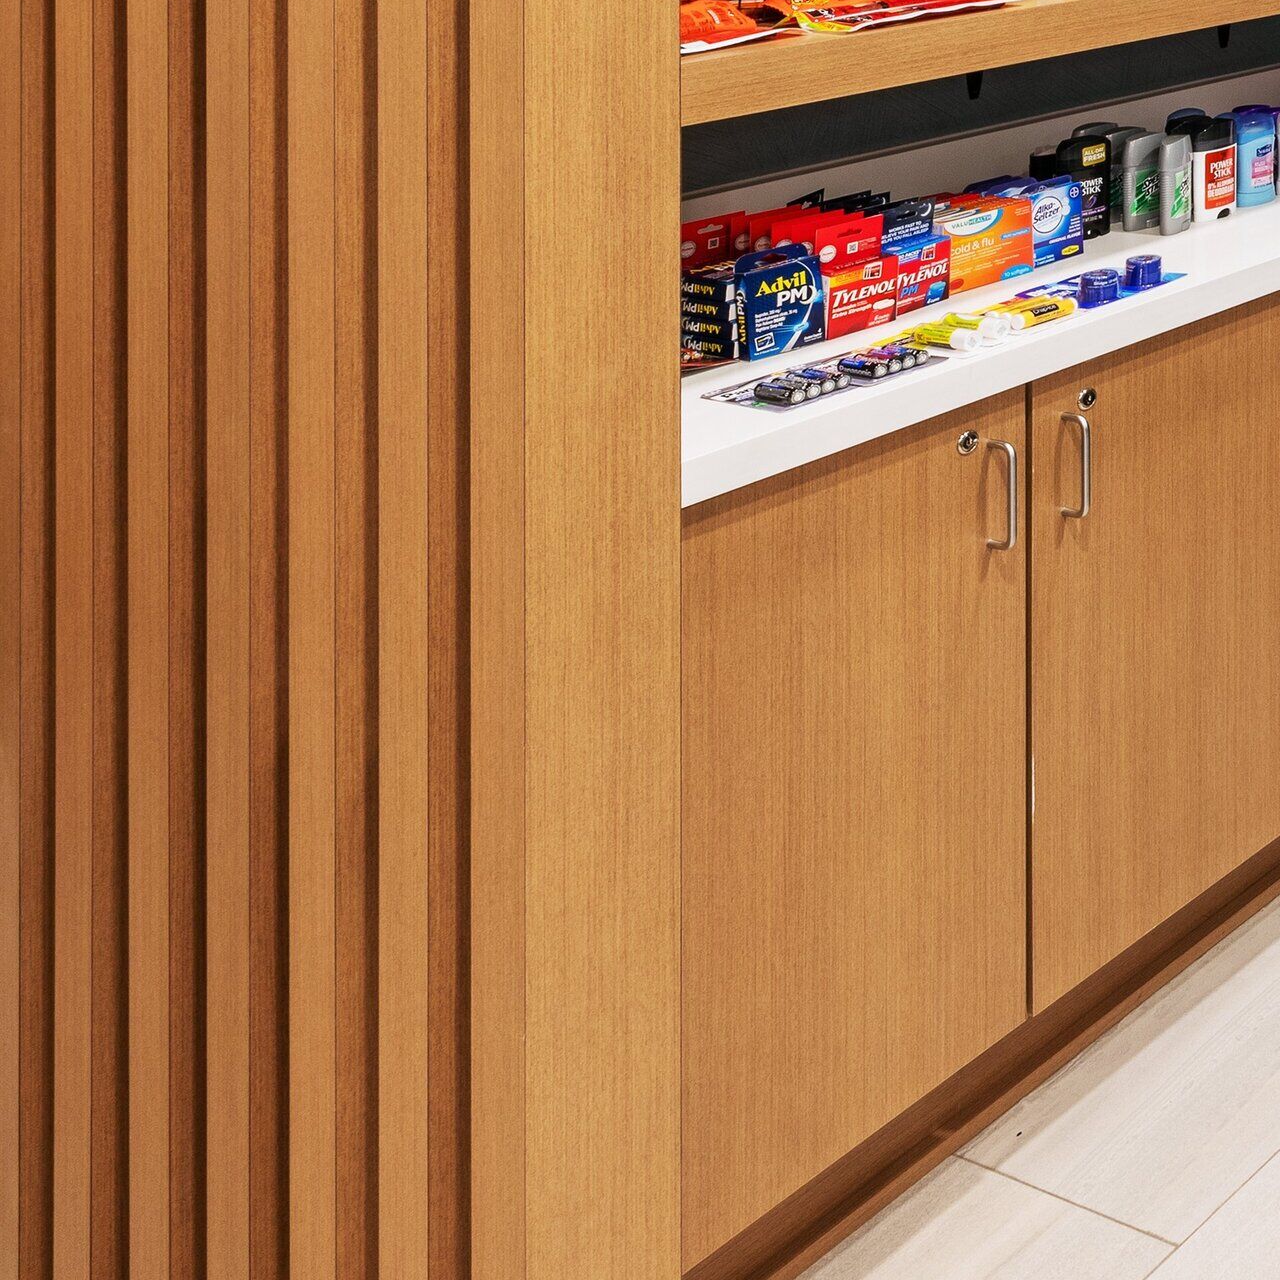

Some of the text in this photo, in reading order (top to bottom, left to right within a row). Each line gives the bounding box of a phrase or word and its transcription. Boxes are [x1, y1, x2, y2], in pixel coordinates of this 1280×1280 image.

[1084, 152, 1105, 162] FRESH
[1210, 158, 1233, 173] POWER
[1214, 168, 1232, 180] STICK
[1082, 186, 1101, 196] STICK
[1034, 206, 1061, 224] Seltzer
[951, 237, 995, 256] cold & flu
[898, 262, 948, 288] TYLENOL
[694, 284, 715, 296] Advil
[755, 270, 808, 298] Advil
[900, 284, 919, 299] PM
[776, 287, 809, 308] PM
[832, 278, 896, 308] TYLENOL
[698, 304, 718, 315] Advil
[700, 323, 721, 334] Advil
[702, 342, 723, 352] Advil
